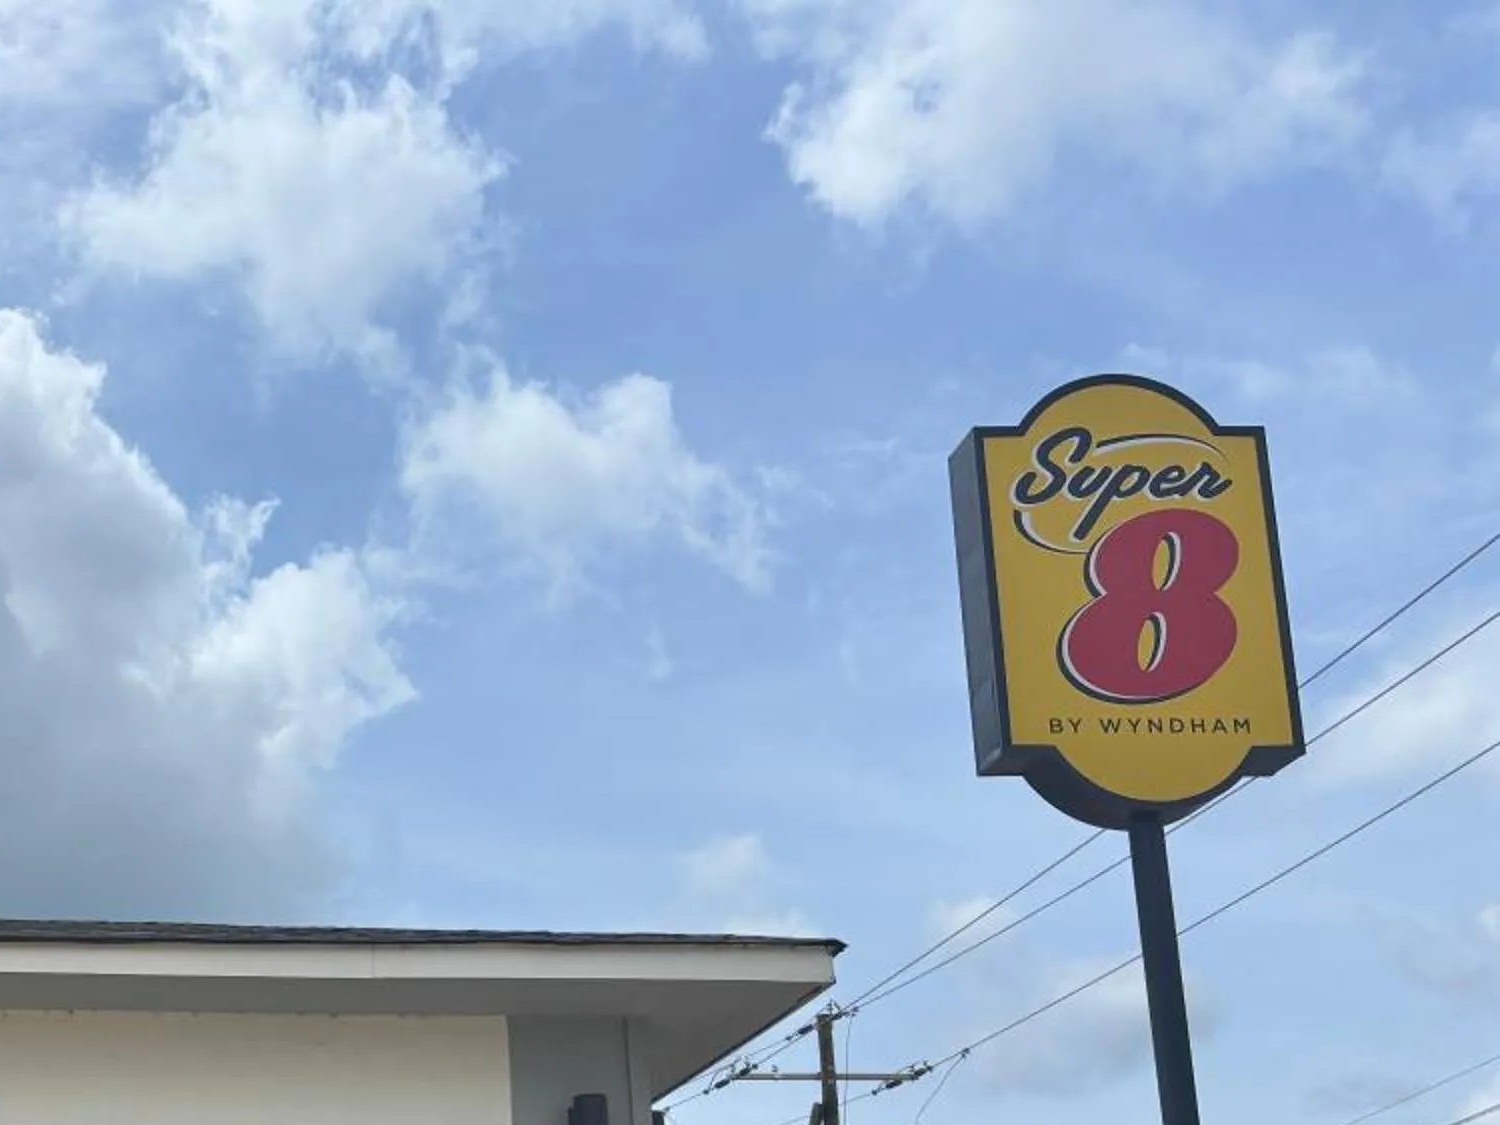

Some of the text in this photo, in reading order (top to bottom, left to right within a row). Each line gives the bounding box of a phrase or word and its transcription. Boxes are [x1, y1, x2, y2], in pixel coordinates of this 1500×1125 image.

[1013, 427, 1233, 540] Super
[1056, 508, 1240, 705] 8
[1049, 717, 1252, 735] BY WYNDHAM
